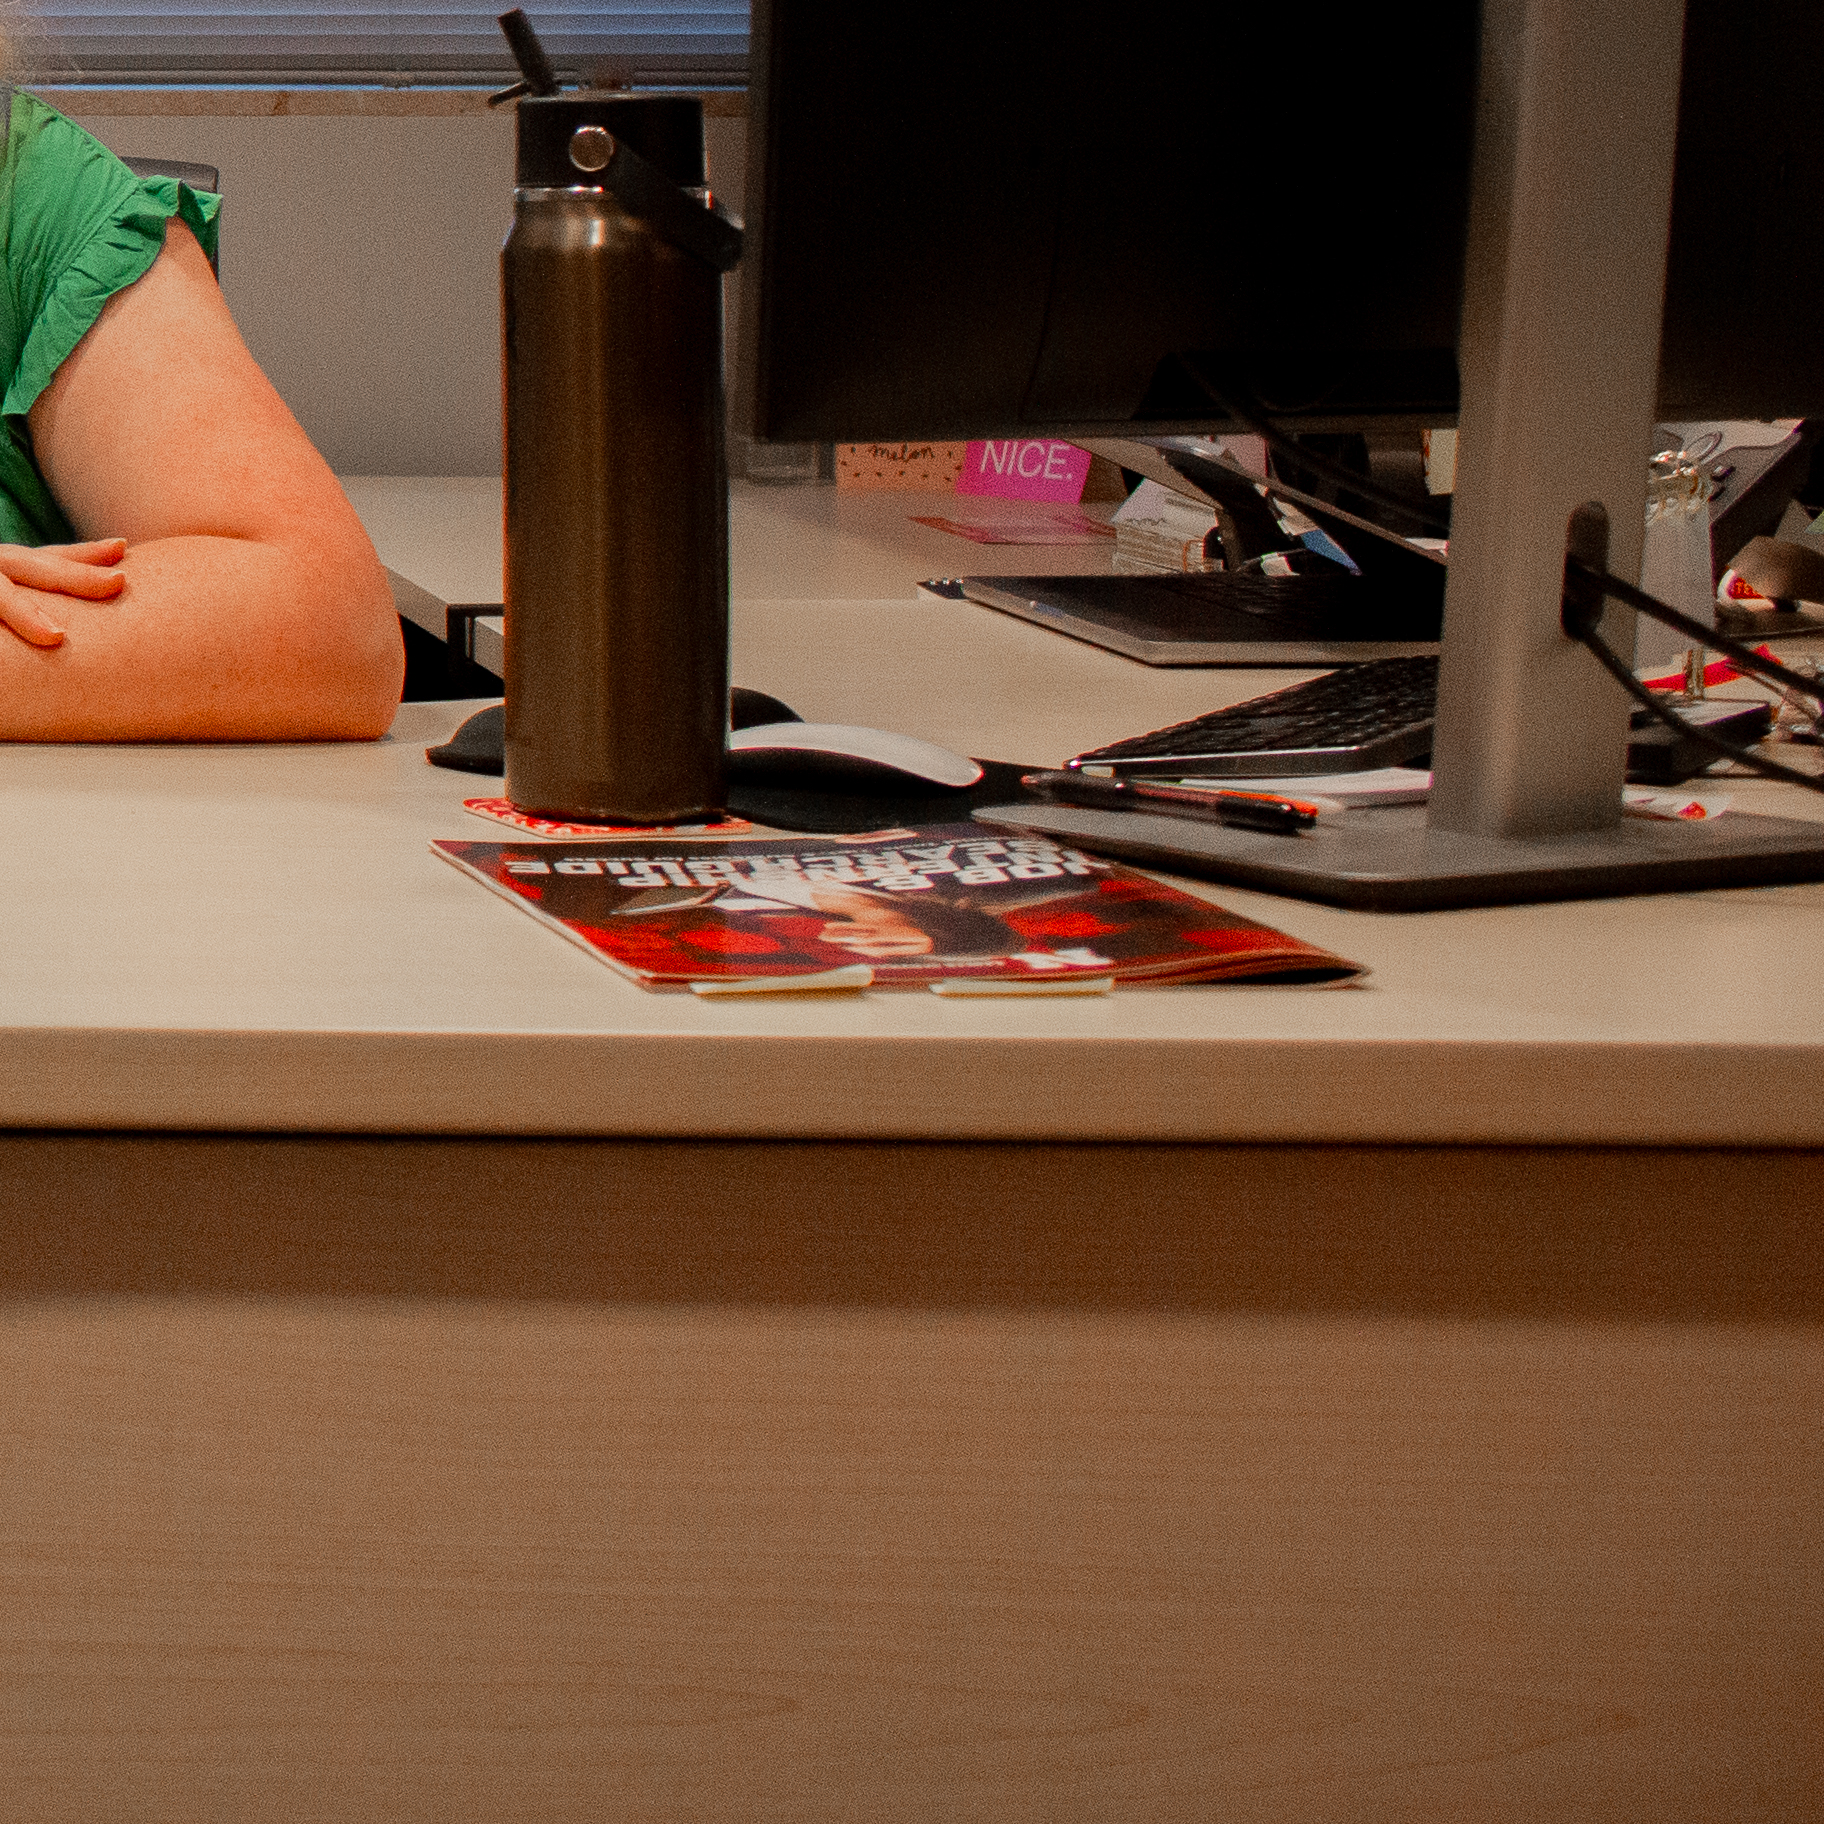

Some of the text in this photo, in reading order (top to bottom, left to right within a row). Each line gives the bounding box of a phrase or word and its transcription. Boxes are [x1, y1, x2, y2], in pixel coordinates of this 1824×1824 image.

[979, 440, 1073, 480] NICE.
[504, 860, 736, 875] GUIDE
[749, 840, 1061, 876] SEARCH
[872, 875, 934, 891] &
